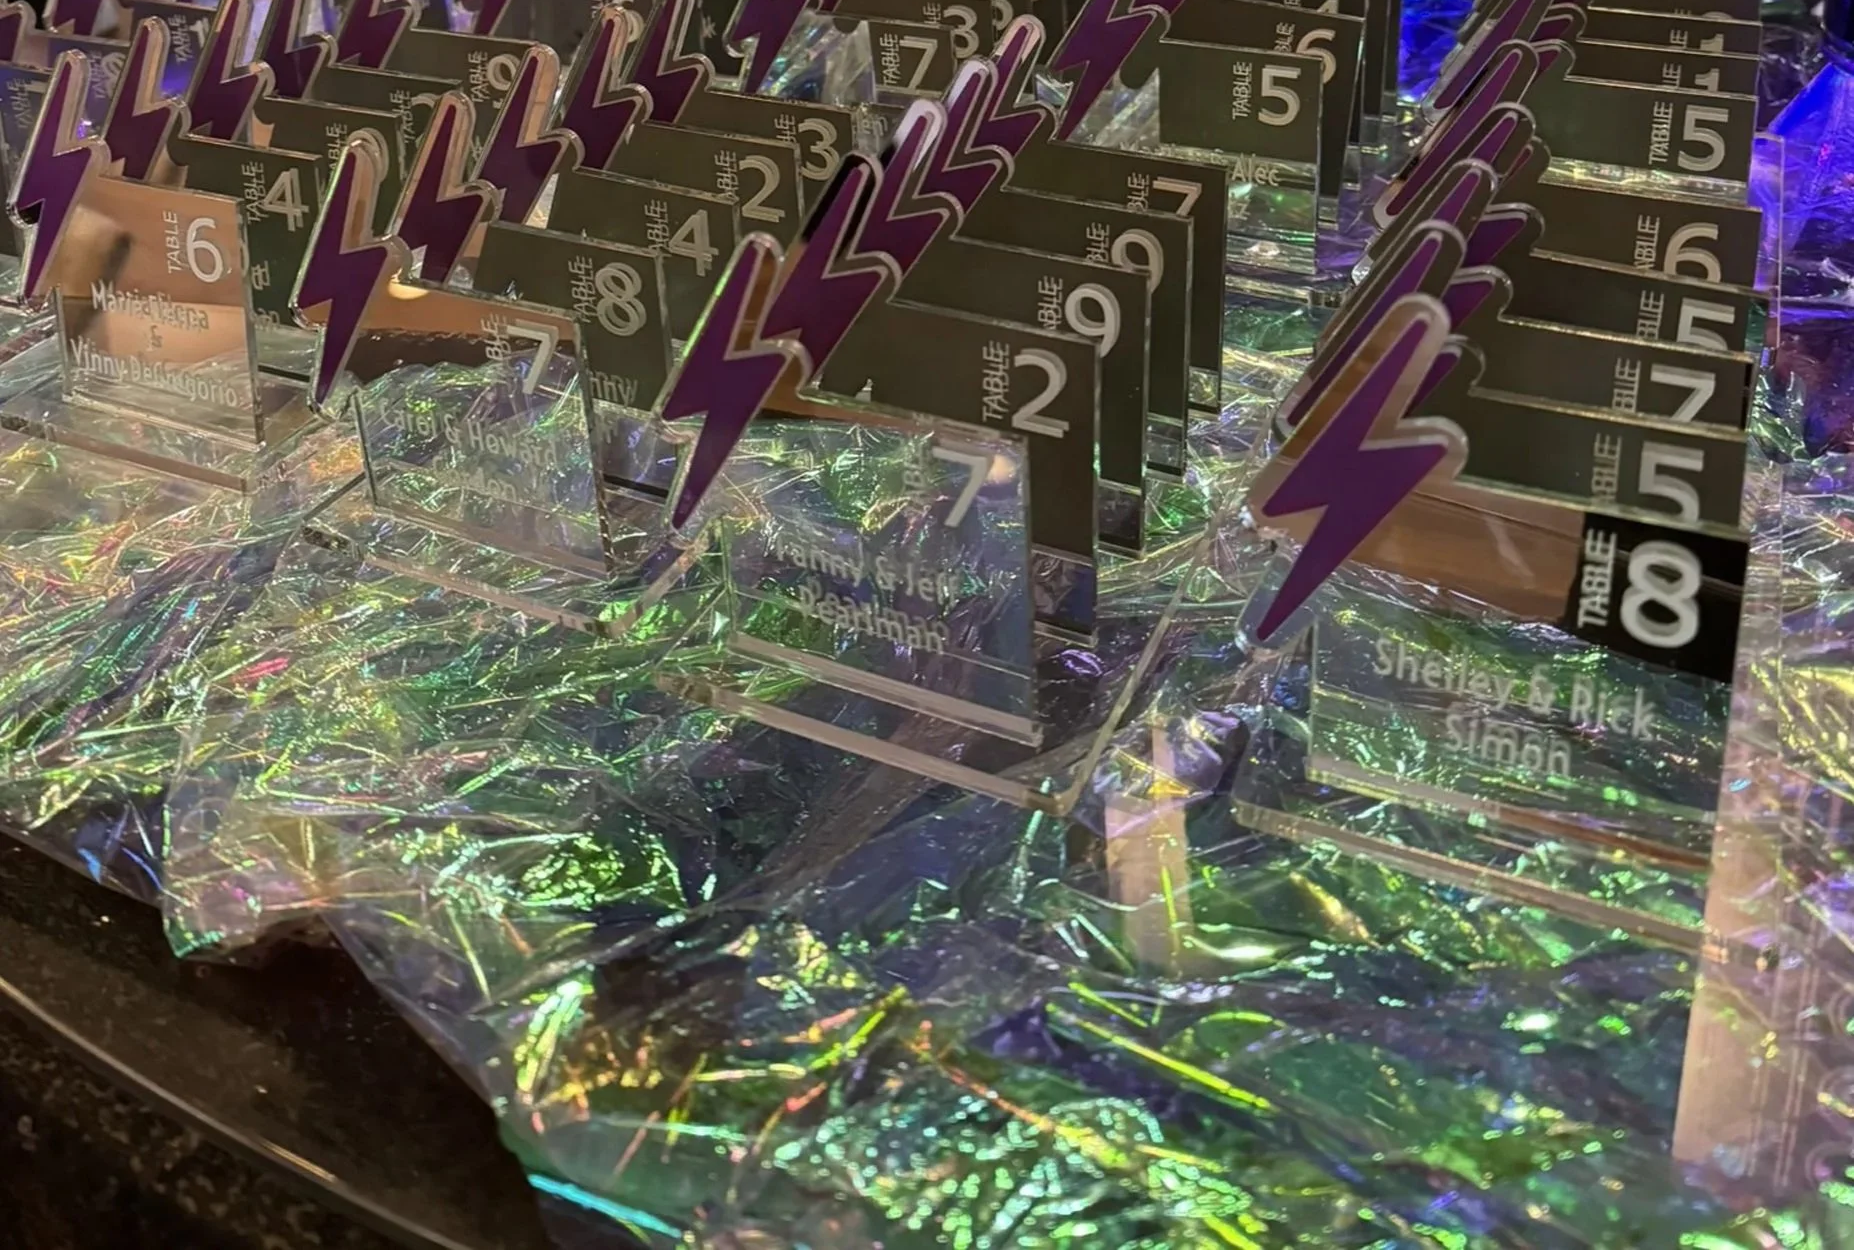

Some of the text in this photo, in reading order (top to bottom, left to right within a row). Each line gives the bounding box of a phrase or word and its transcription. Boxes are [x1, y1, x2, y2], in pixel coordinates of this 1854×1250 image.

[879, 32, 939, 91] TABLE 7
[943, 4, 980, 59] 3
[1274, 21, 1337, 85] BLE 6
[468, 50, 490, 103] TABLE
[1231, 61, 1302, 127] TABLE 5
[797, 117, 840, 181] 3
[1648, 100, 1730, 172] TABLE 5
[240, 161, 310, 233] TABLE 4
[738, 154, 786, 223] 2
[1126, 171, 1152, 213] BLE
[1152, 176, 1203, 217] 7
[162, 210, 230, 284] TABLE 6
[667, 209, 720, 278] 4
[1085, 221, 1165, 296] BLE 9
[1663, 221, 1722, 284] 6
[567, 254, 648, 337] TABLE 8
[1064, 282, 1121, 359] 9
[1636, 289, 1737, 350] BLE 5
[504, 318, 560, 395] 7
[982, 339, 1070, 440] TABLE 2
[1612, 357, 1716, 424] BLE 7
[931, 445, 990, 529] 7
[1638, 441, 1705, 523] 5
[1577, 527, 1703, 649] TABLE 8
[1373, 636, 1658, 742] Shelley & Rick
[1445, 702, 1573, 778] Simon
